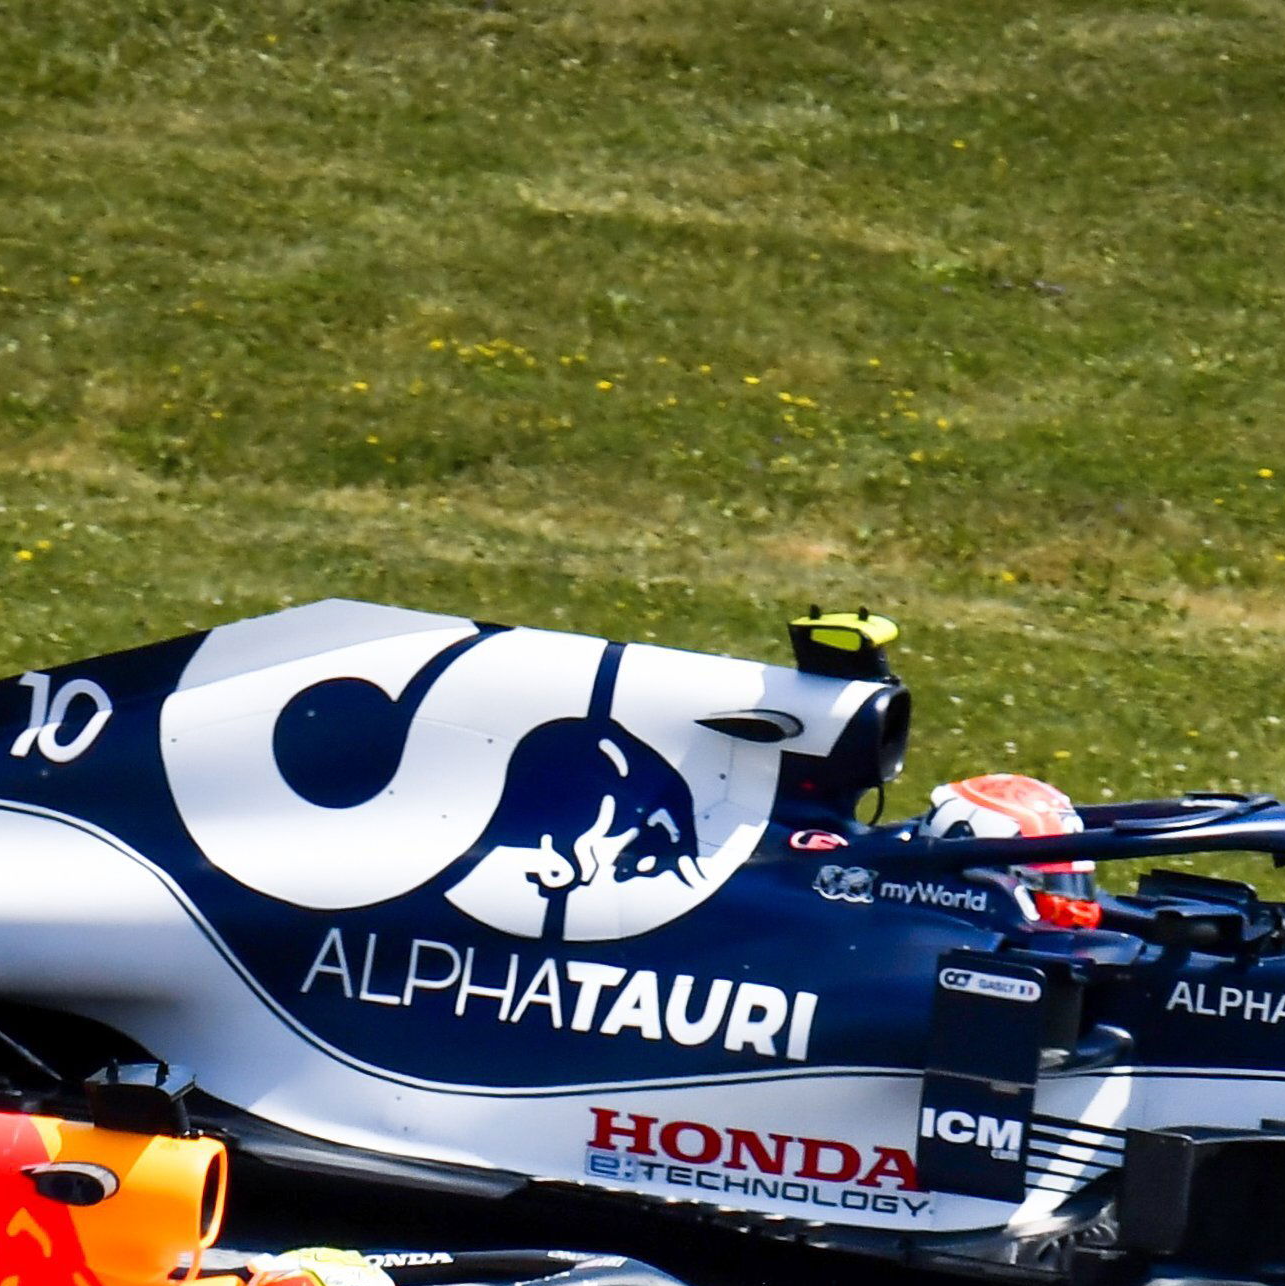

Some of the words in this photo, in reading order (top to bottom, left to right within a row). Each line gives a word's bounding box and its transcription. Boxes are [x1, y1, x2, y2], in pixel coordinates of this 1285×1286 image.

[8, 671, 112, 765] 10
[879, 880, 988, 912] myWorld
[301, 927, 817, 1061] ALPHATAURI
[587, 1107, 928, 1193] HONDA
[920, 1107, 1023, 1152] ICM
[362, 1252, 455, 1268] ONDA
